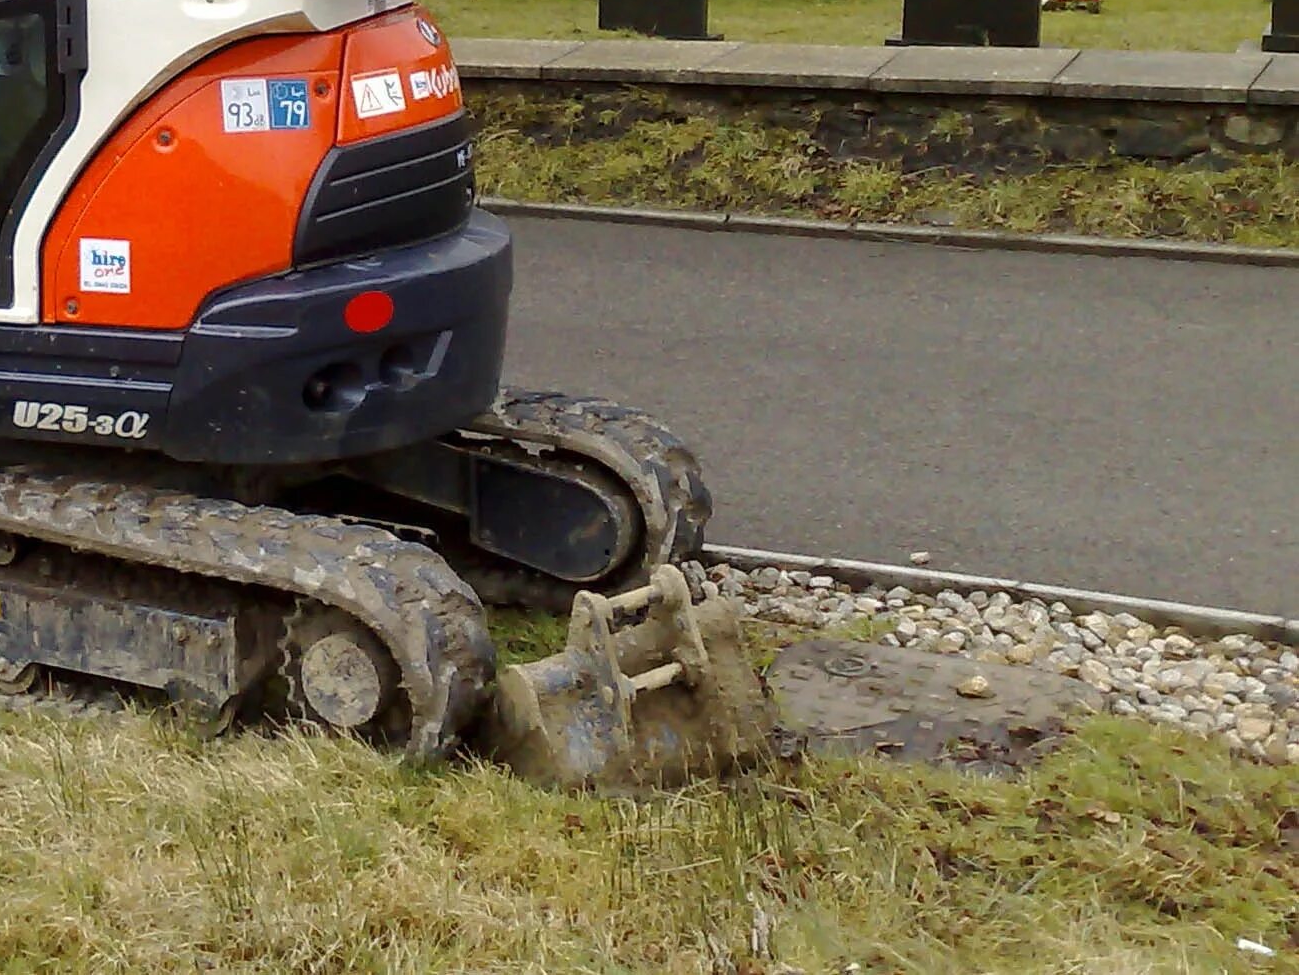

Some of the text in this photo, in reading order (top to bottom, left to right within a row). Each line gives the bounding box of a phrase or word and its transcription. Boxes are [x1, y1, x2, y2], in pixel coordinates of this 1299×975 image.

[228, 102, 254, 127] 93
[279, 100, 306, 127] 79
[92, 249, 126, 267] hire
[94, 267, 125, 278] one
